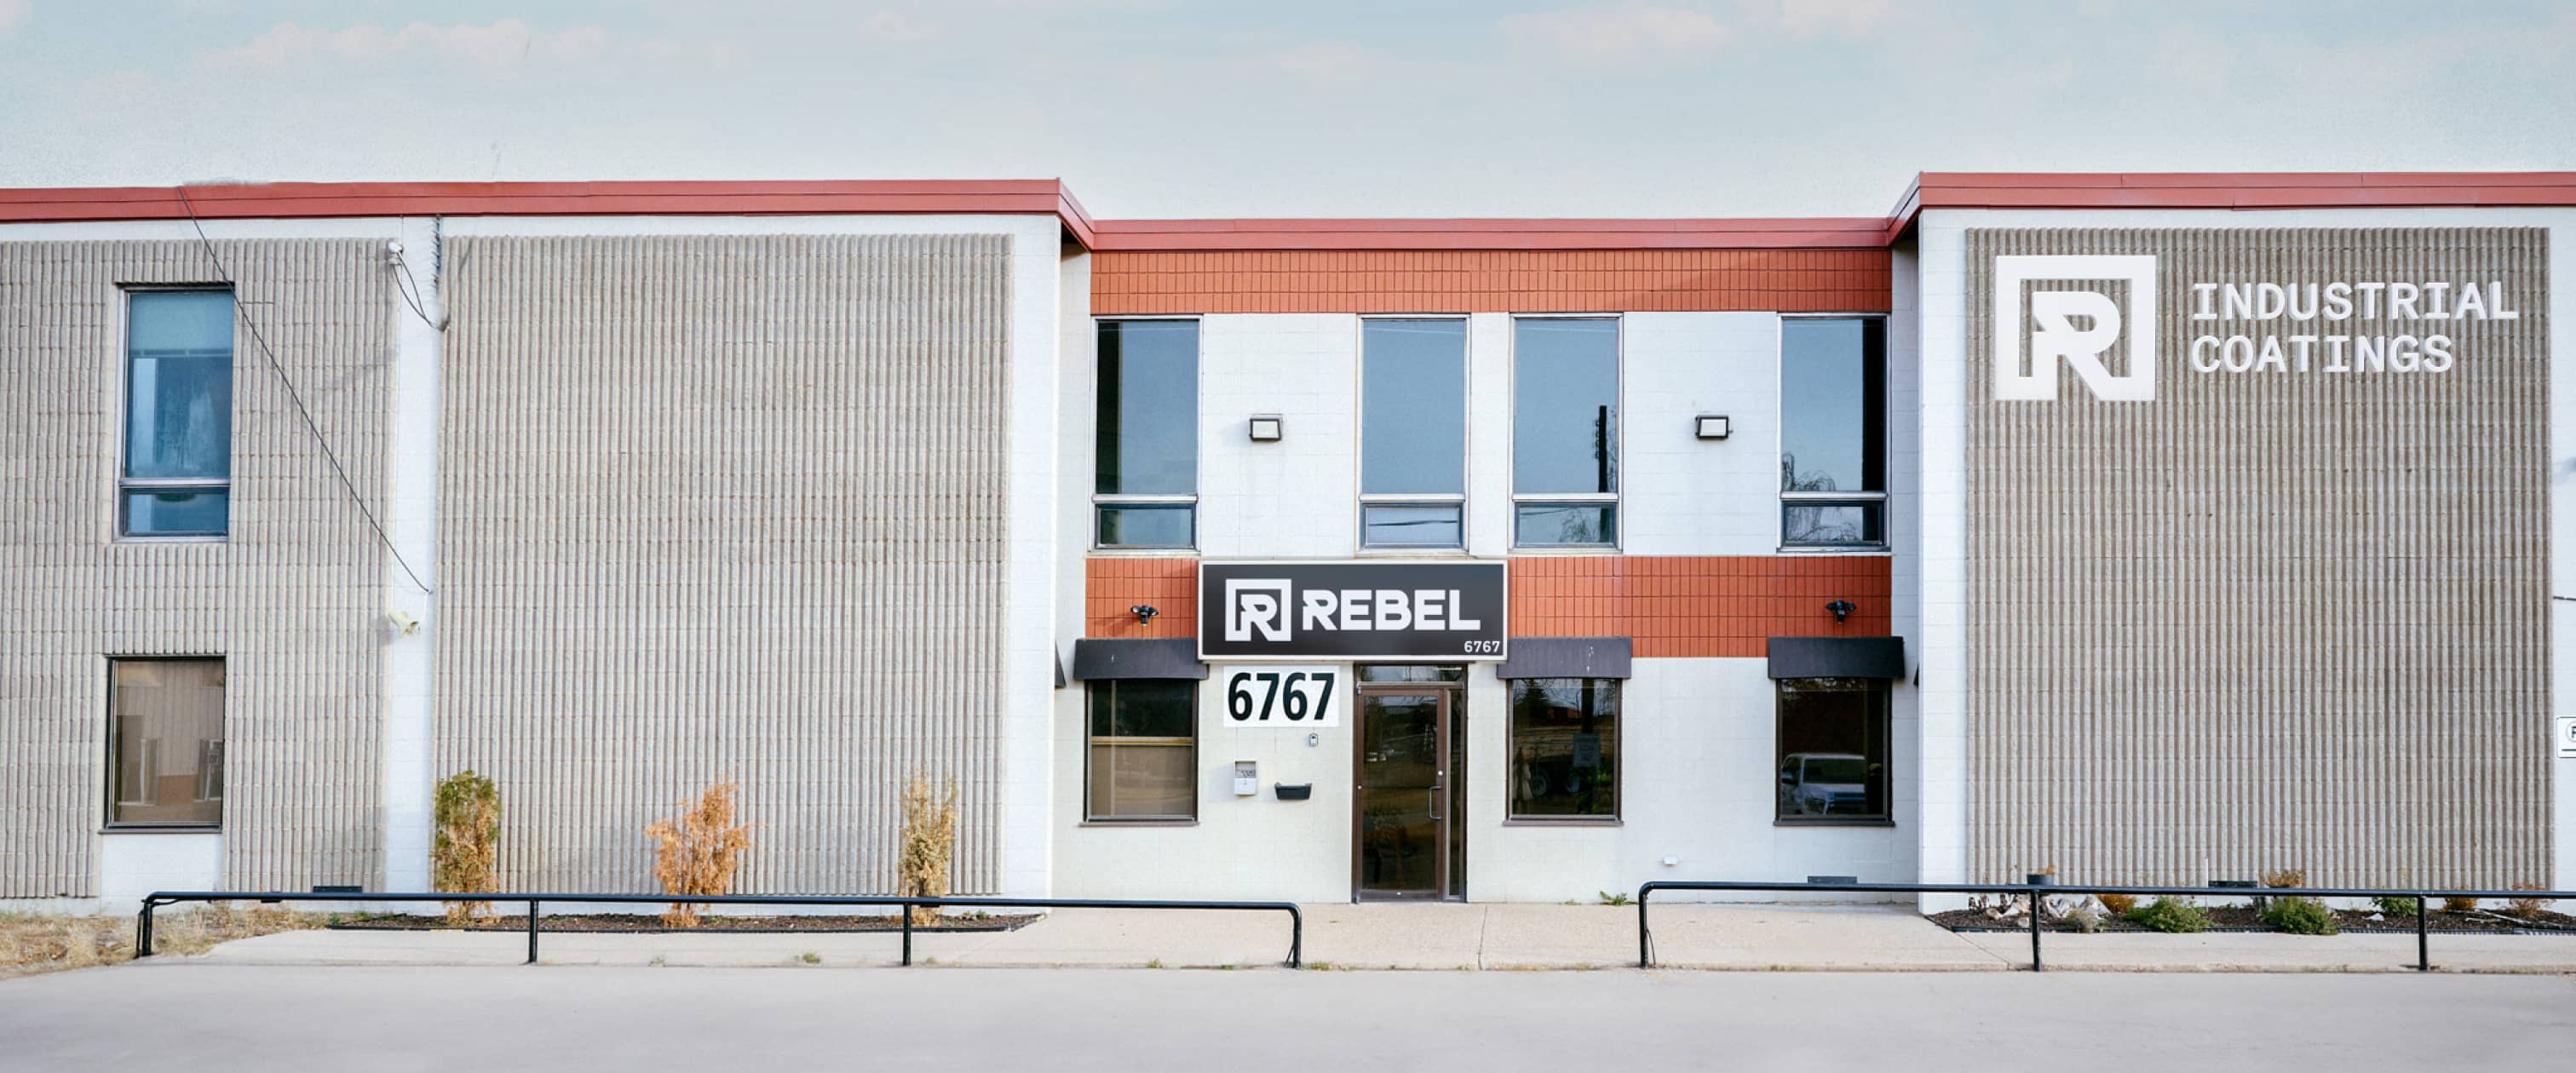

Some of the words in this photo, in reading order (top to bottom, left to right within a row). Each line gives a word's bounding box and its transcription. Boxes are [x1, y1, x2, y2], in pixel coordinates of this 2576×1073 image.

[2192, 282, 2519, 320] INDUSTRIAL
[2191, 335, 2453, 373] COATINGS
[1302, 589, 1481, 631] REBEL
[1463, 640, 1500, 653] 6767
[1228, 672, 1335, 721] 6767
